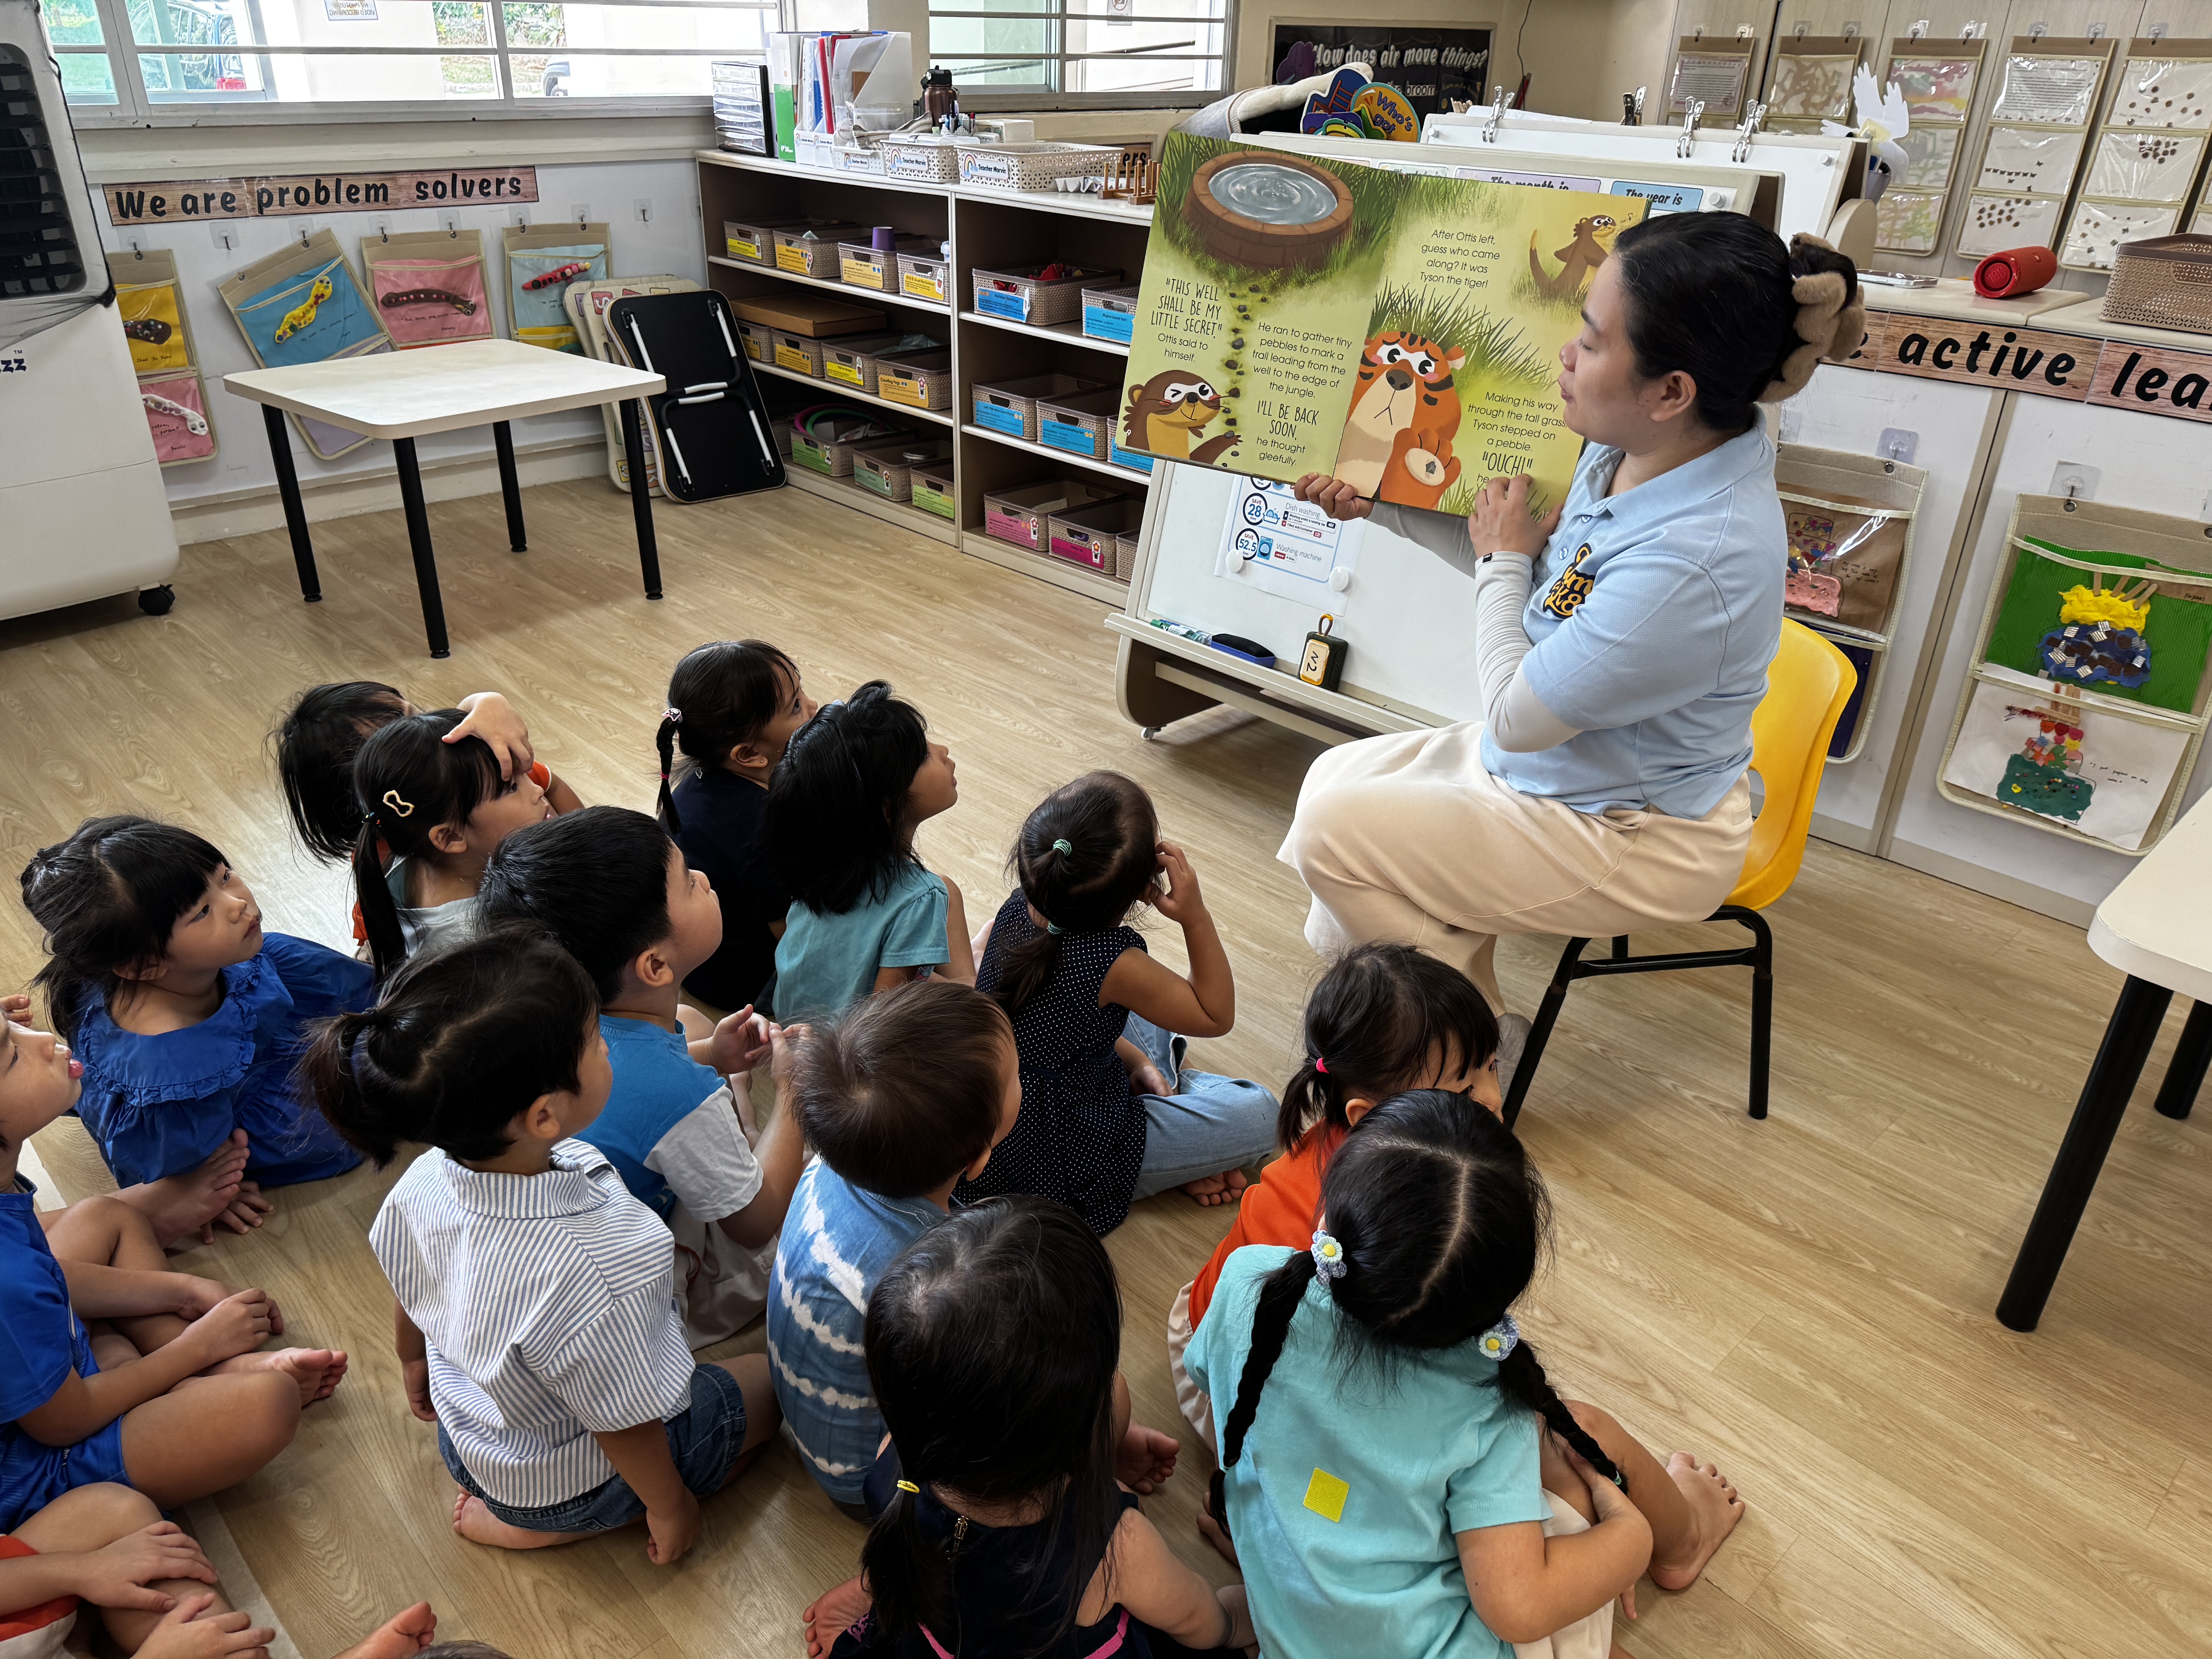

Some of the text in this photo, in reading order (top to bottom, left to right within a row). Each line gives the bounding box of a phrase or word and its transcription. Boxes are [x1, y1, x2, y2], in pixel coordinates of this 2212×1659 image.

[1345, 45, 1377, 66] does
[1380, 45, 1400, 68] air
[1403, 48, 1439, 67] move
[1441, 47, 1487, 72] things?
[1405, 81, 1436, 96] broom
[1377, 91, 1413, 131] Who's
[1374, 114, 1396, 134] got
[115, 173, 522, 219] We are problem solvers
[1673, 193, 1683, 205] is
[1431, 230, 1496, 245] After Ottis left,
[1421, 244, 1500, 260] guess who came
[1427, 259, 1488, 274] along? It was
[1166, 278, 1219, 301] "THIS WELL
[1420, 271, 1488, 289] Tyson the tiger!
[1158, 295, 1221, 320] SHALL BE MY
[1151, 311, 1178, 330] LITTLE
[1158, 333, 1208, 350] Ottis said to
[1258, 322, 1353, 349] He ran to gather tiny
[1164, 348, 1196, 362] himself.
[1260, 337, 1344, 361] pebbles to mark a
[1252, 350, 1346, 375] trail leading from the
[1898, 331, 2076, 386] active
[2111, 352, 2212, 410] lea
[1253, 365, 1340, 388] well to the edge of
[1269, 381, 1316, 398] the jungle.
[1485, 391, 1558, 412] Making his way
[1257, 400, 1319, 426] I'LL BE BACK
[1468, 404, 1504, 421] through
[1507, 410, 1522, 421] the
[1525, 413, 1540, 423] tall
[1473, 419, 1556, 440] Tyson stepped on
[1256, 436, 1306, 454] he thought
[1487, 436, 1532, 452] a pebble.
[1259, 451, 1296, 466] gleefully.
[1477, 473, 1489, 484] he
[1248, 503, 1262, 517] 28
[1286, 503, 1320, 519] Dish washing
[1239, 538, 1257, 552] 52.5
[1277, 543, 1322, 562] Washing machine
[1307, 651, 1319, 672] N2
